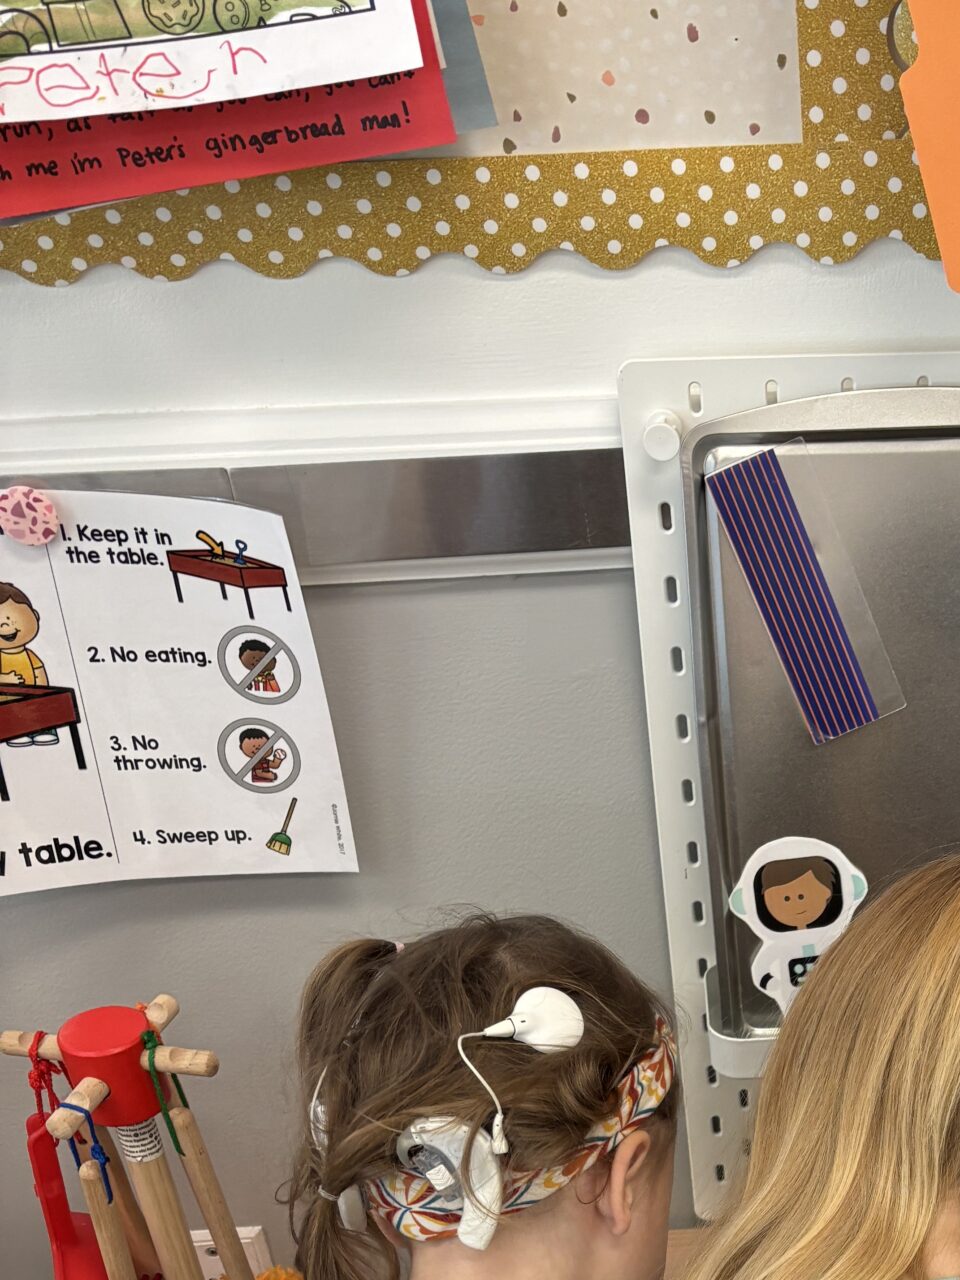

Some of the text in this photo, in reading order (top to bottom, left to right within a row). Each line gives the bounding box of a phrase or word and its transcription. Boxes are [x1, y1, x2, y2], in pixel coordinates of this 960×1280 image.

[26, 160, 58, 177] me
[205, 114, 345, 158] gingerbread
[360, 100, 411, 132] man!
[76, 523, 129, 546] Keep
[133, 526, 148, 544] it
[153, 528, 173, 546] in
[65, 545, 165, 566] the table.
[87, 646, 212, 668] 2. No eating.
[109, 735, 159, 751] 3. No
[113, 754, 207, 772] throwing.
[132, 828, 253, 846] 4. Sweep up.
[18, 835, 113, 867] table.
